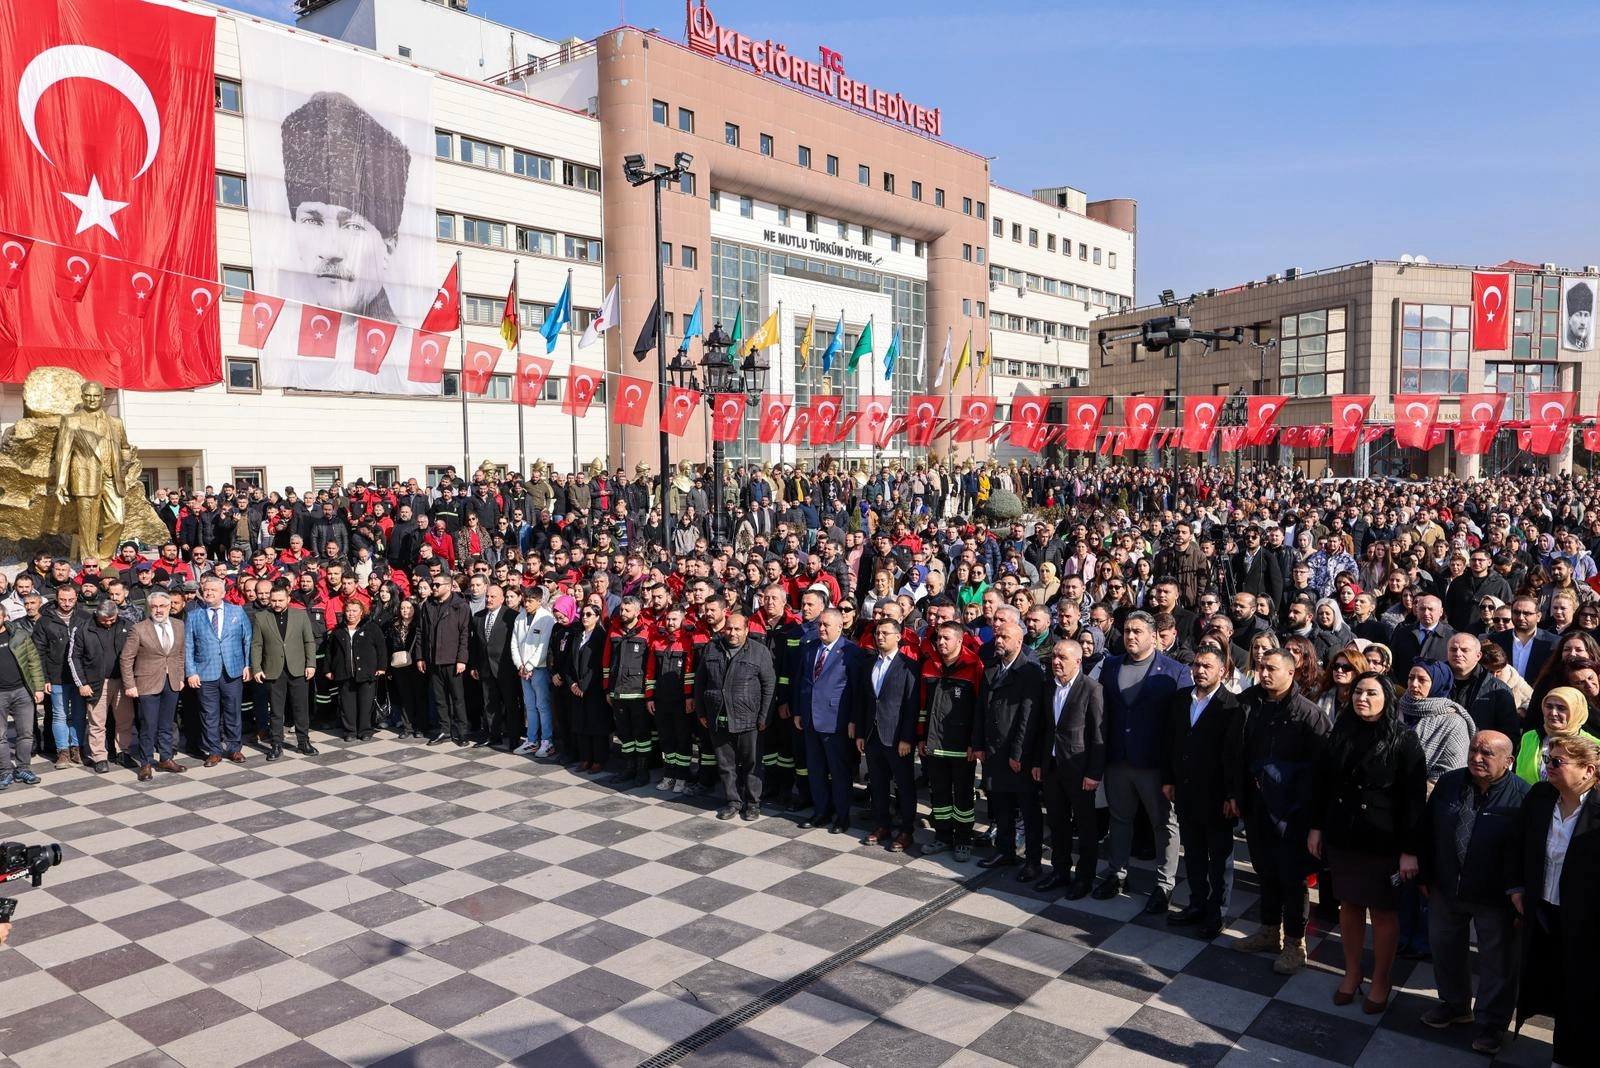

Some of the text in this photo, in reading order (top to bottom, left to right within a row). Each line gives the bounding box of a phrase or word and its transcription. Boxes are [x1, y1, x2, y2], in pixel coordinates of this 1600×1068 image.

[716, 26, 941, 136] KEÇİÖREN BELEDİYESİ
[763, 229, 776, 243] NE
[778, 232, 807, 249] MUTLU
[809, 238, 843, 256] TÜRKÜM
